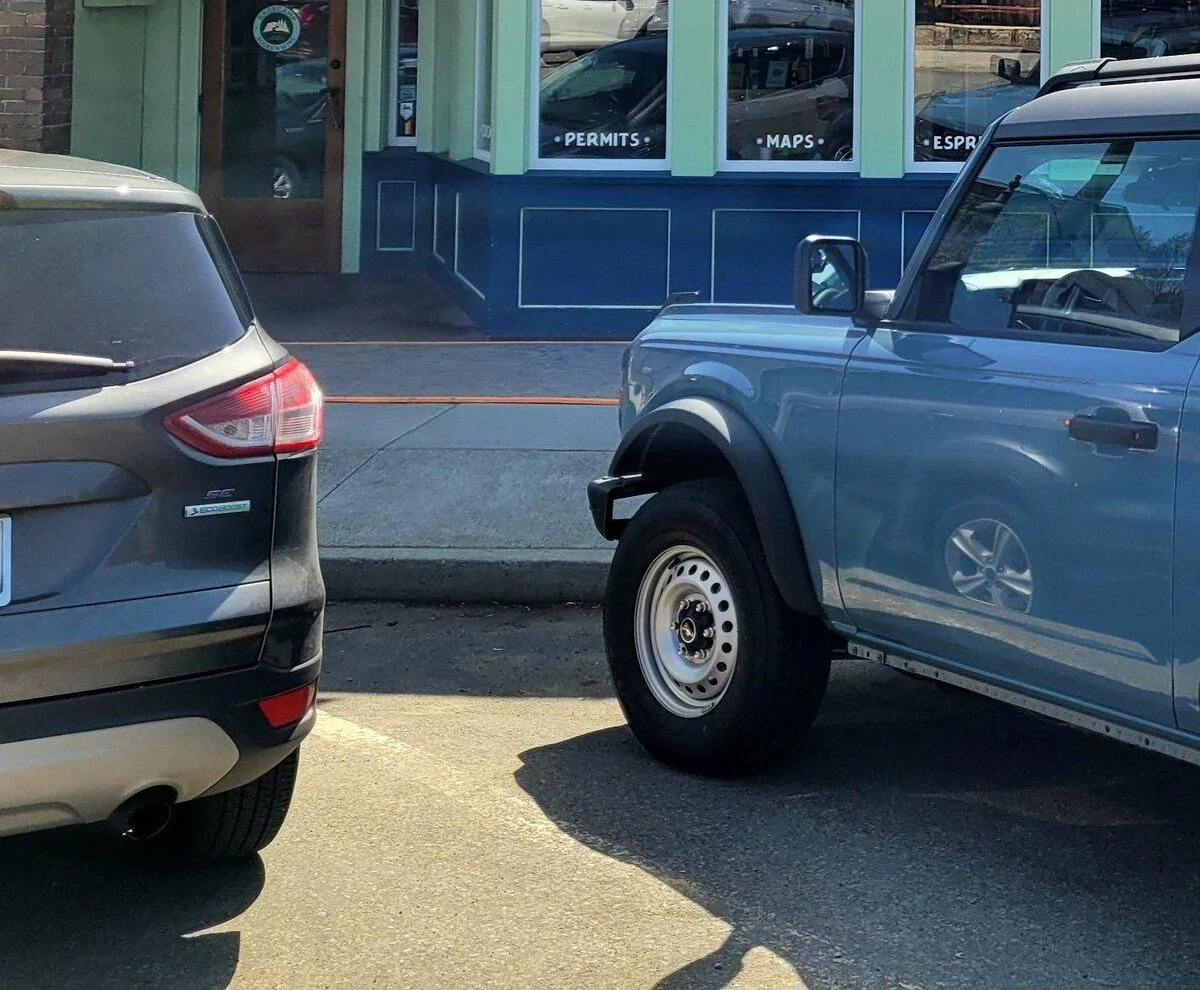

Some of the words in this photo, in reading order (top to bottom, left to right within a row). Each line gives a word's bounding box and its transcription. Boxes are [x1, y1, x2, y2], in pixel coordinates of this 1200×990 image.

[564, 132, 640, 147] PERMITS
[766, 134, 814, 149] MAPS
[204, 488, 236, 500] SE
[200, 503, 248, 514] ECOBOOST
